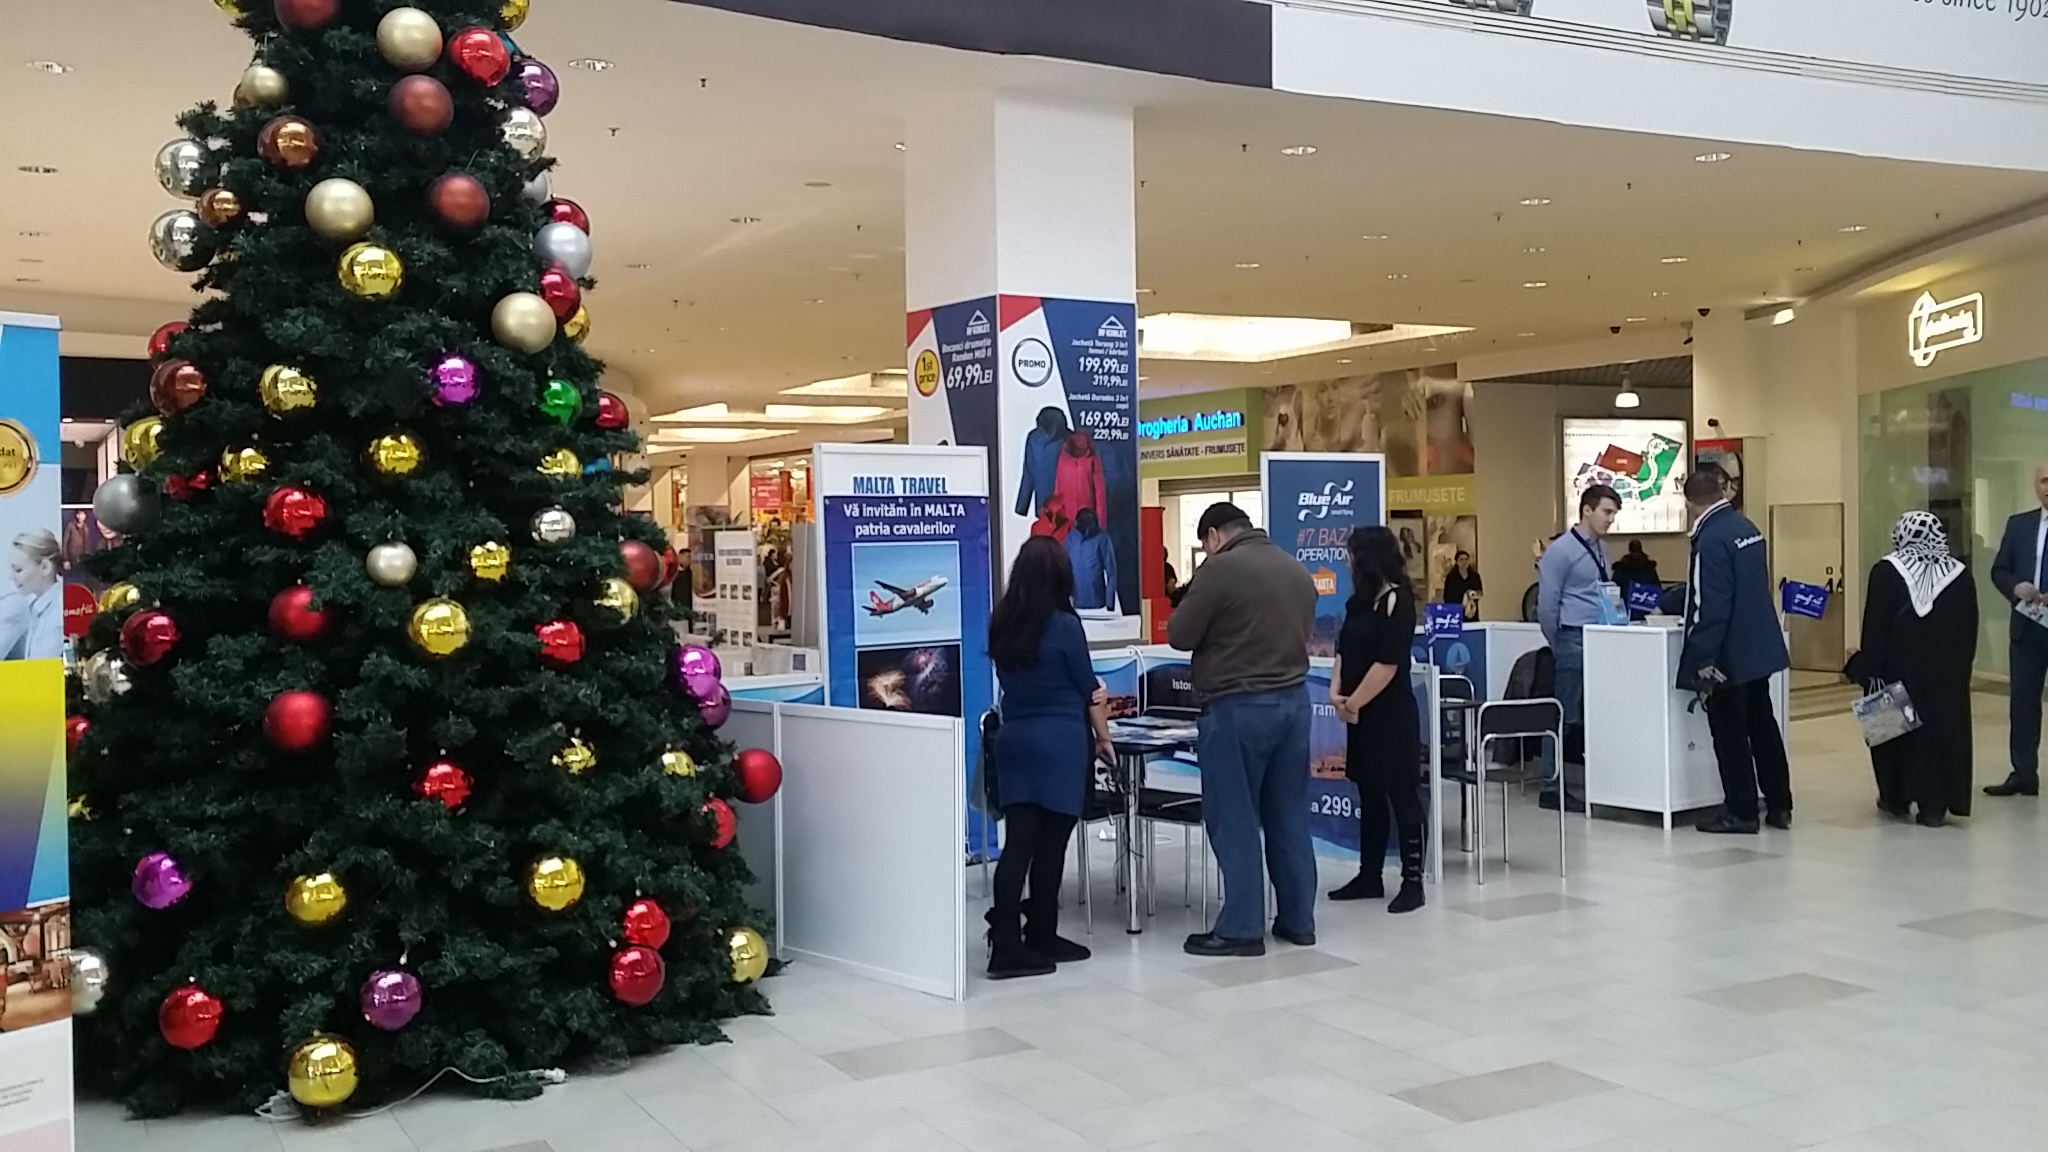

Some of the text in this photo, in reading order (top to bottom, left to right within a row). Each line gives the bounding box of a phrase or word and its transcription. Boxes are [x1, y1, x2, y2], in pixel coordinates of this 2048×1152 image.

[922, 356, 933, 371] 1st
[1018, 359, 1046, 368] PROMO
[919, 373, 936, 384] price
[1194, 410, 1242, 431] Auchan
[853, 476, 948, 494] MALTA TRAVEL
[1298, 492, 1354, 506] Blue Air
[843, 503, 966, 518] Vă invităm în MALTA
[854, 521, 956, 538] patria cavalerilor
[1297, 527, 1315, 546] #7
[1321, 794, 1352, 818] 299
